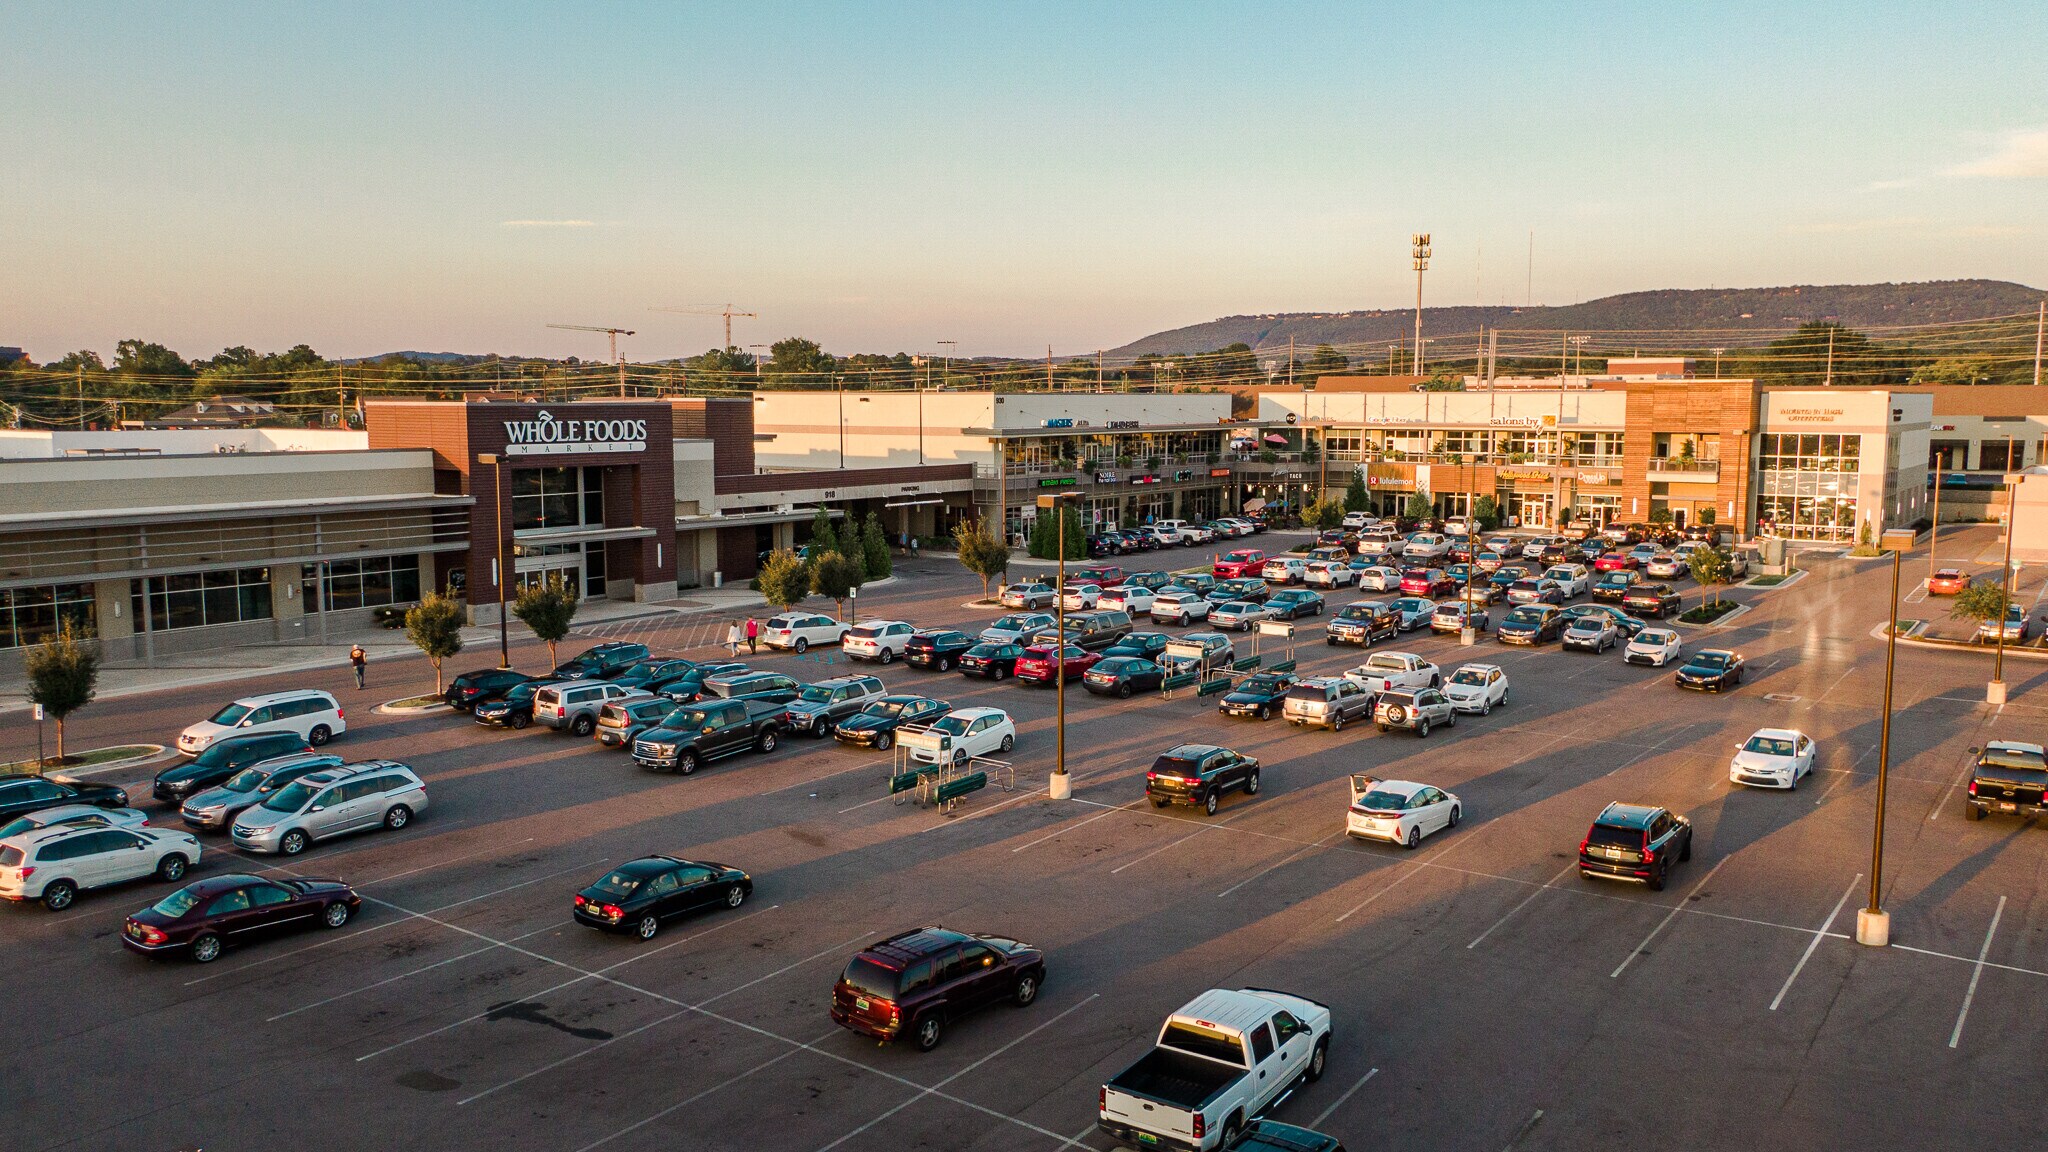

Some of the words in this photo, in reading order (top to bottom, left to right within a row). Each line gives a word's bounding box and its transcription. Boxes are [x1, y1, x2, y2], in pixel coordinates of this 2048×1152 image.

[504, 411, 582, 443] WHOLE
[584, 420, 647, 441] FOODS
[1490, 416, 1524, 426] salons
[1526, 416, 1538, 428] by
[521, 443, 633, 453] MARKET
[1379, 477, 1414, 485] lululemon
[825, 491, 835, 499] 918
